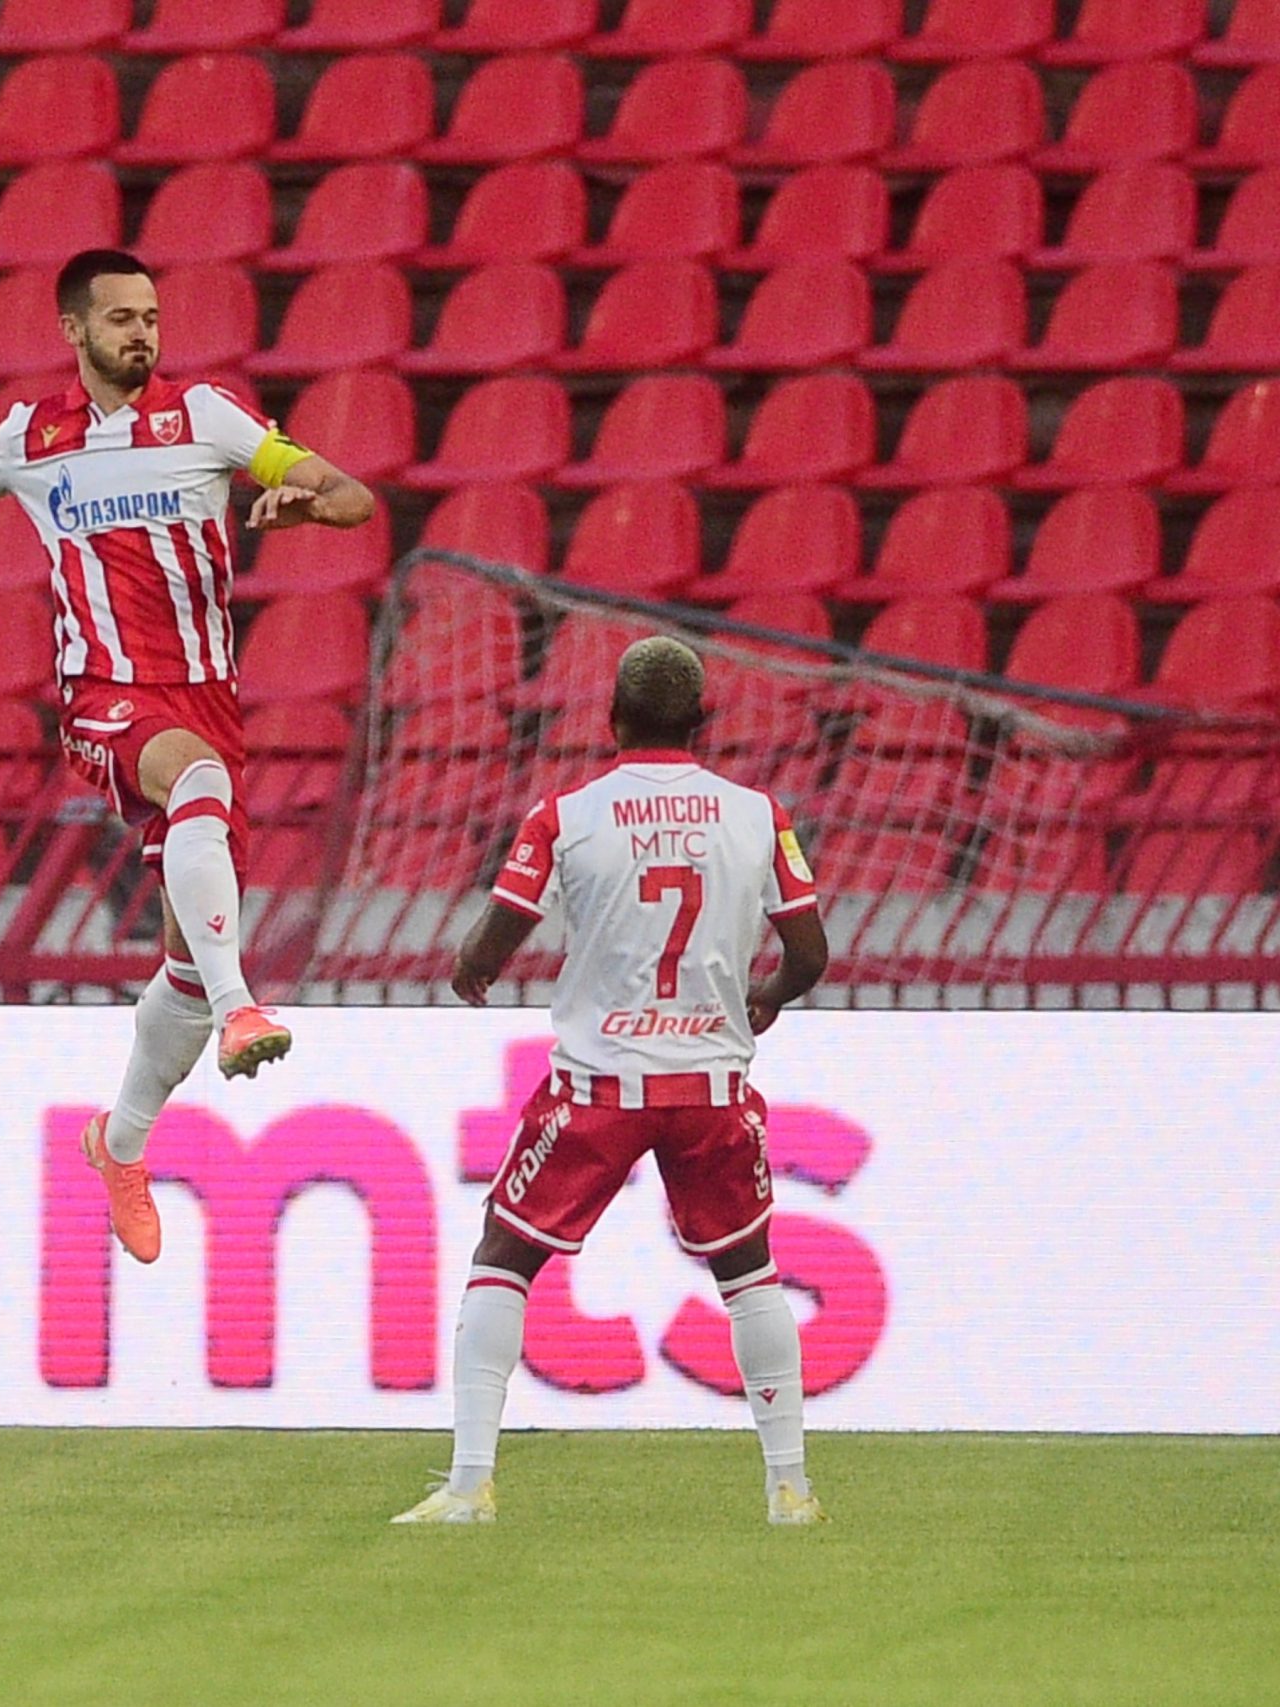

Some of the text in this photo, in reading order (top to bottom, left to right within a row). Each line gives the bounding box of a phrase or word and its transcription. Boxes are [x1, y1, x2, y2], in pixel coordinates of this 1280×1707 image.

[80, 489, 181, 528] ГАЗПРОМ
[612, 795, 720, 828] МИЛСОН
[639, 866, 703, 999] 7
